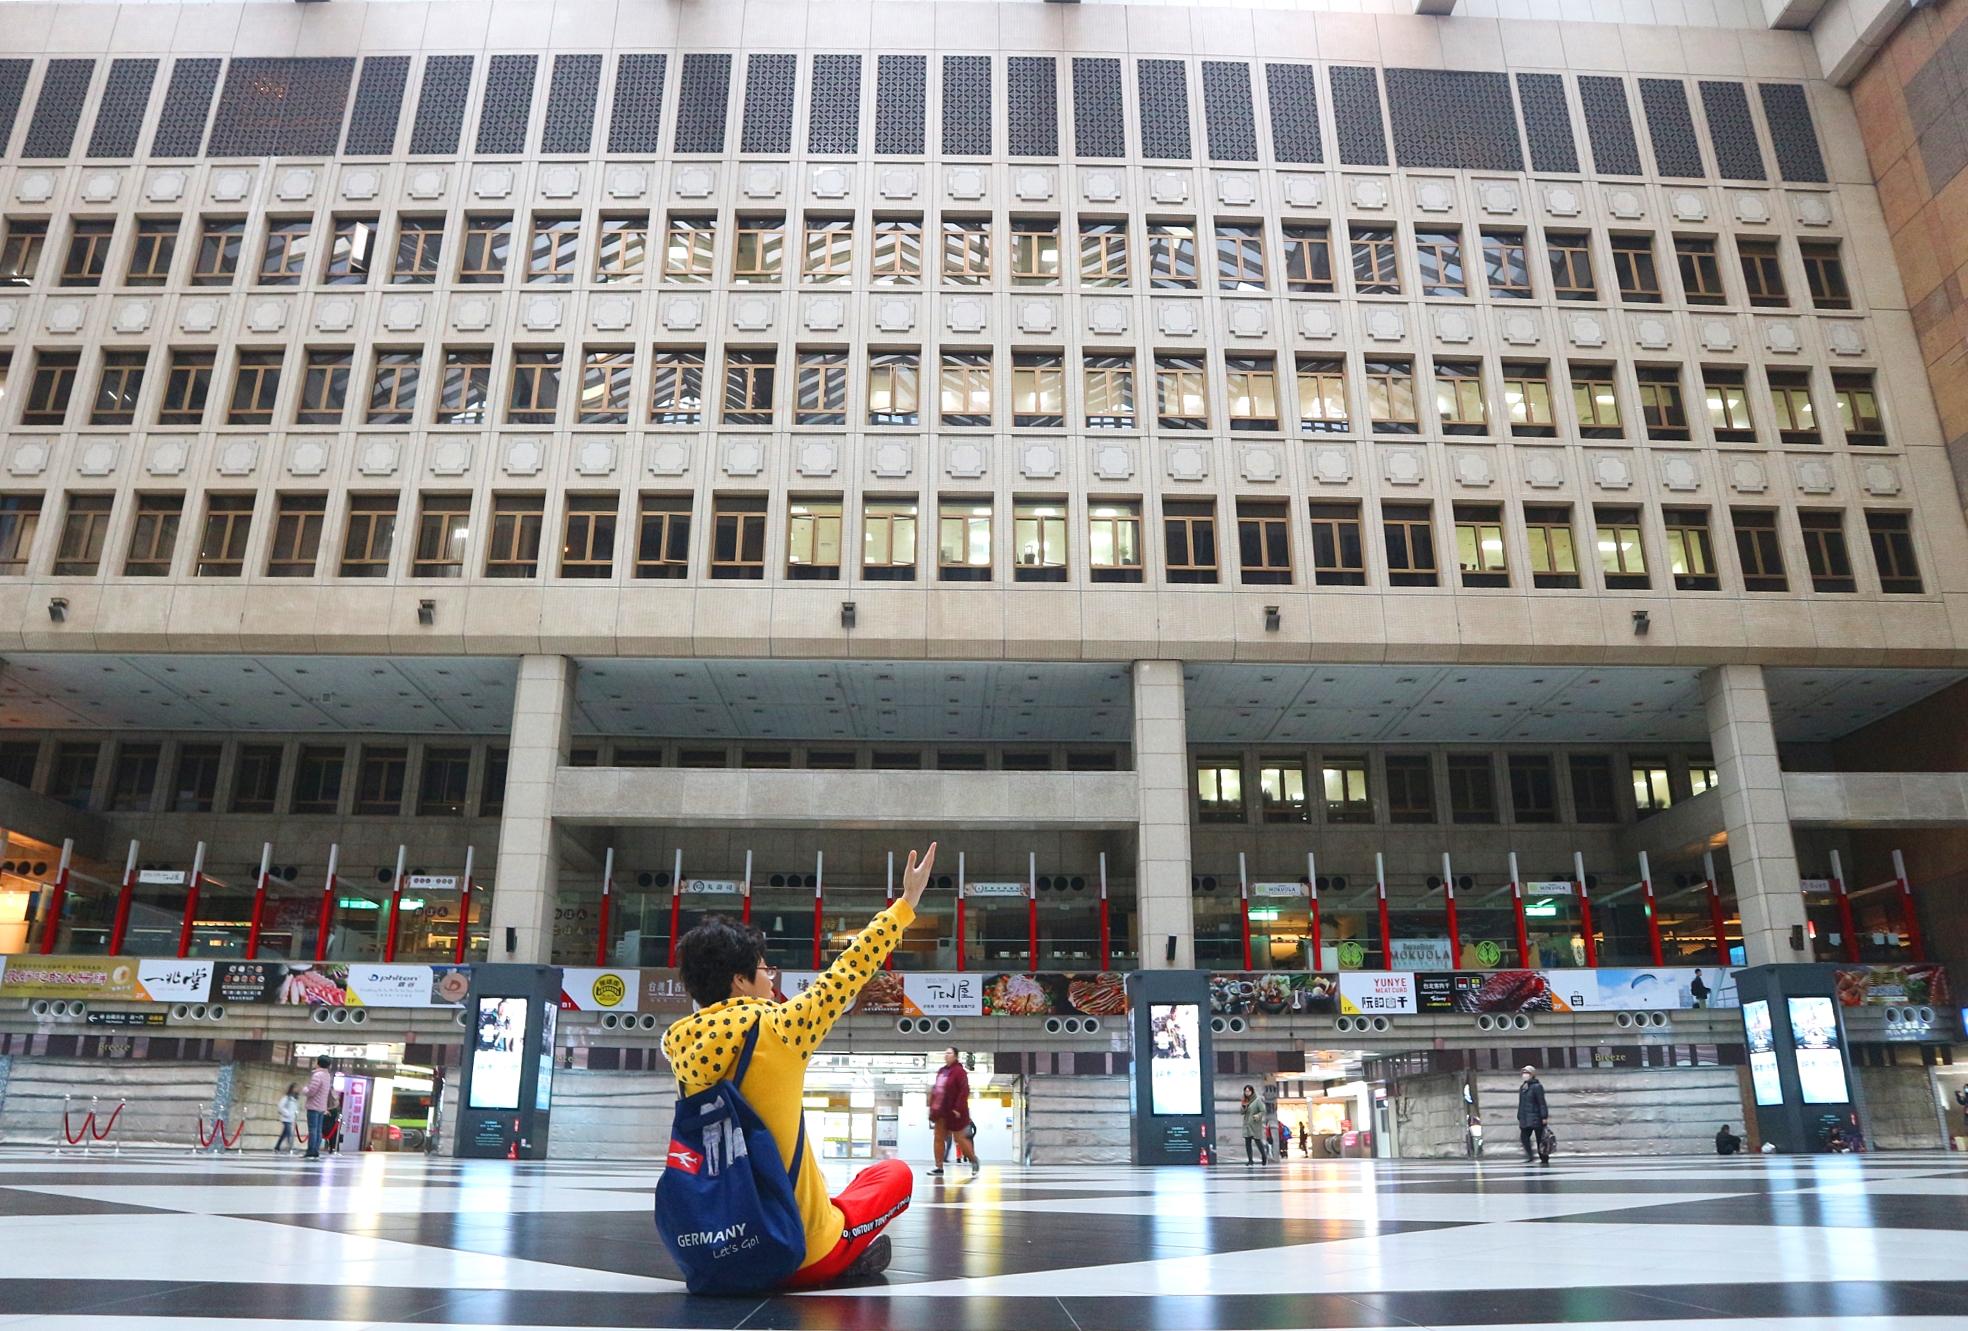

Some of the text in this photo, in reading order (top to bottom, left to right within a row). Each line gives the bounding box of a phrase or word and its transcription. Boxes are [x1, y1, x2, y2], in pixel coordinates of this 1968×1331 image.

[1374, 978, 1407, 987] YUNYE
[1594, 1052, 1627, 1062] Breeze
[677, 1222, 746, 1248] GERMANY
[712, 1235, 760, 1259] Let's Go!
